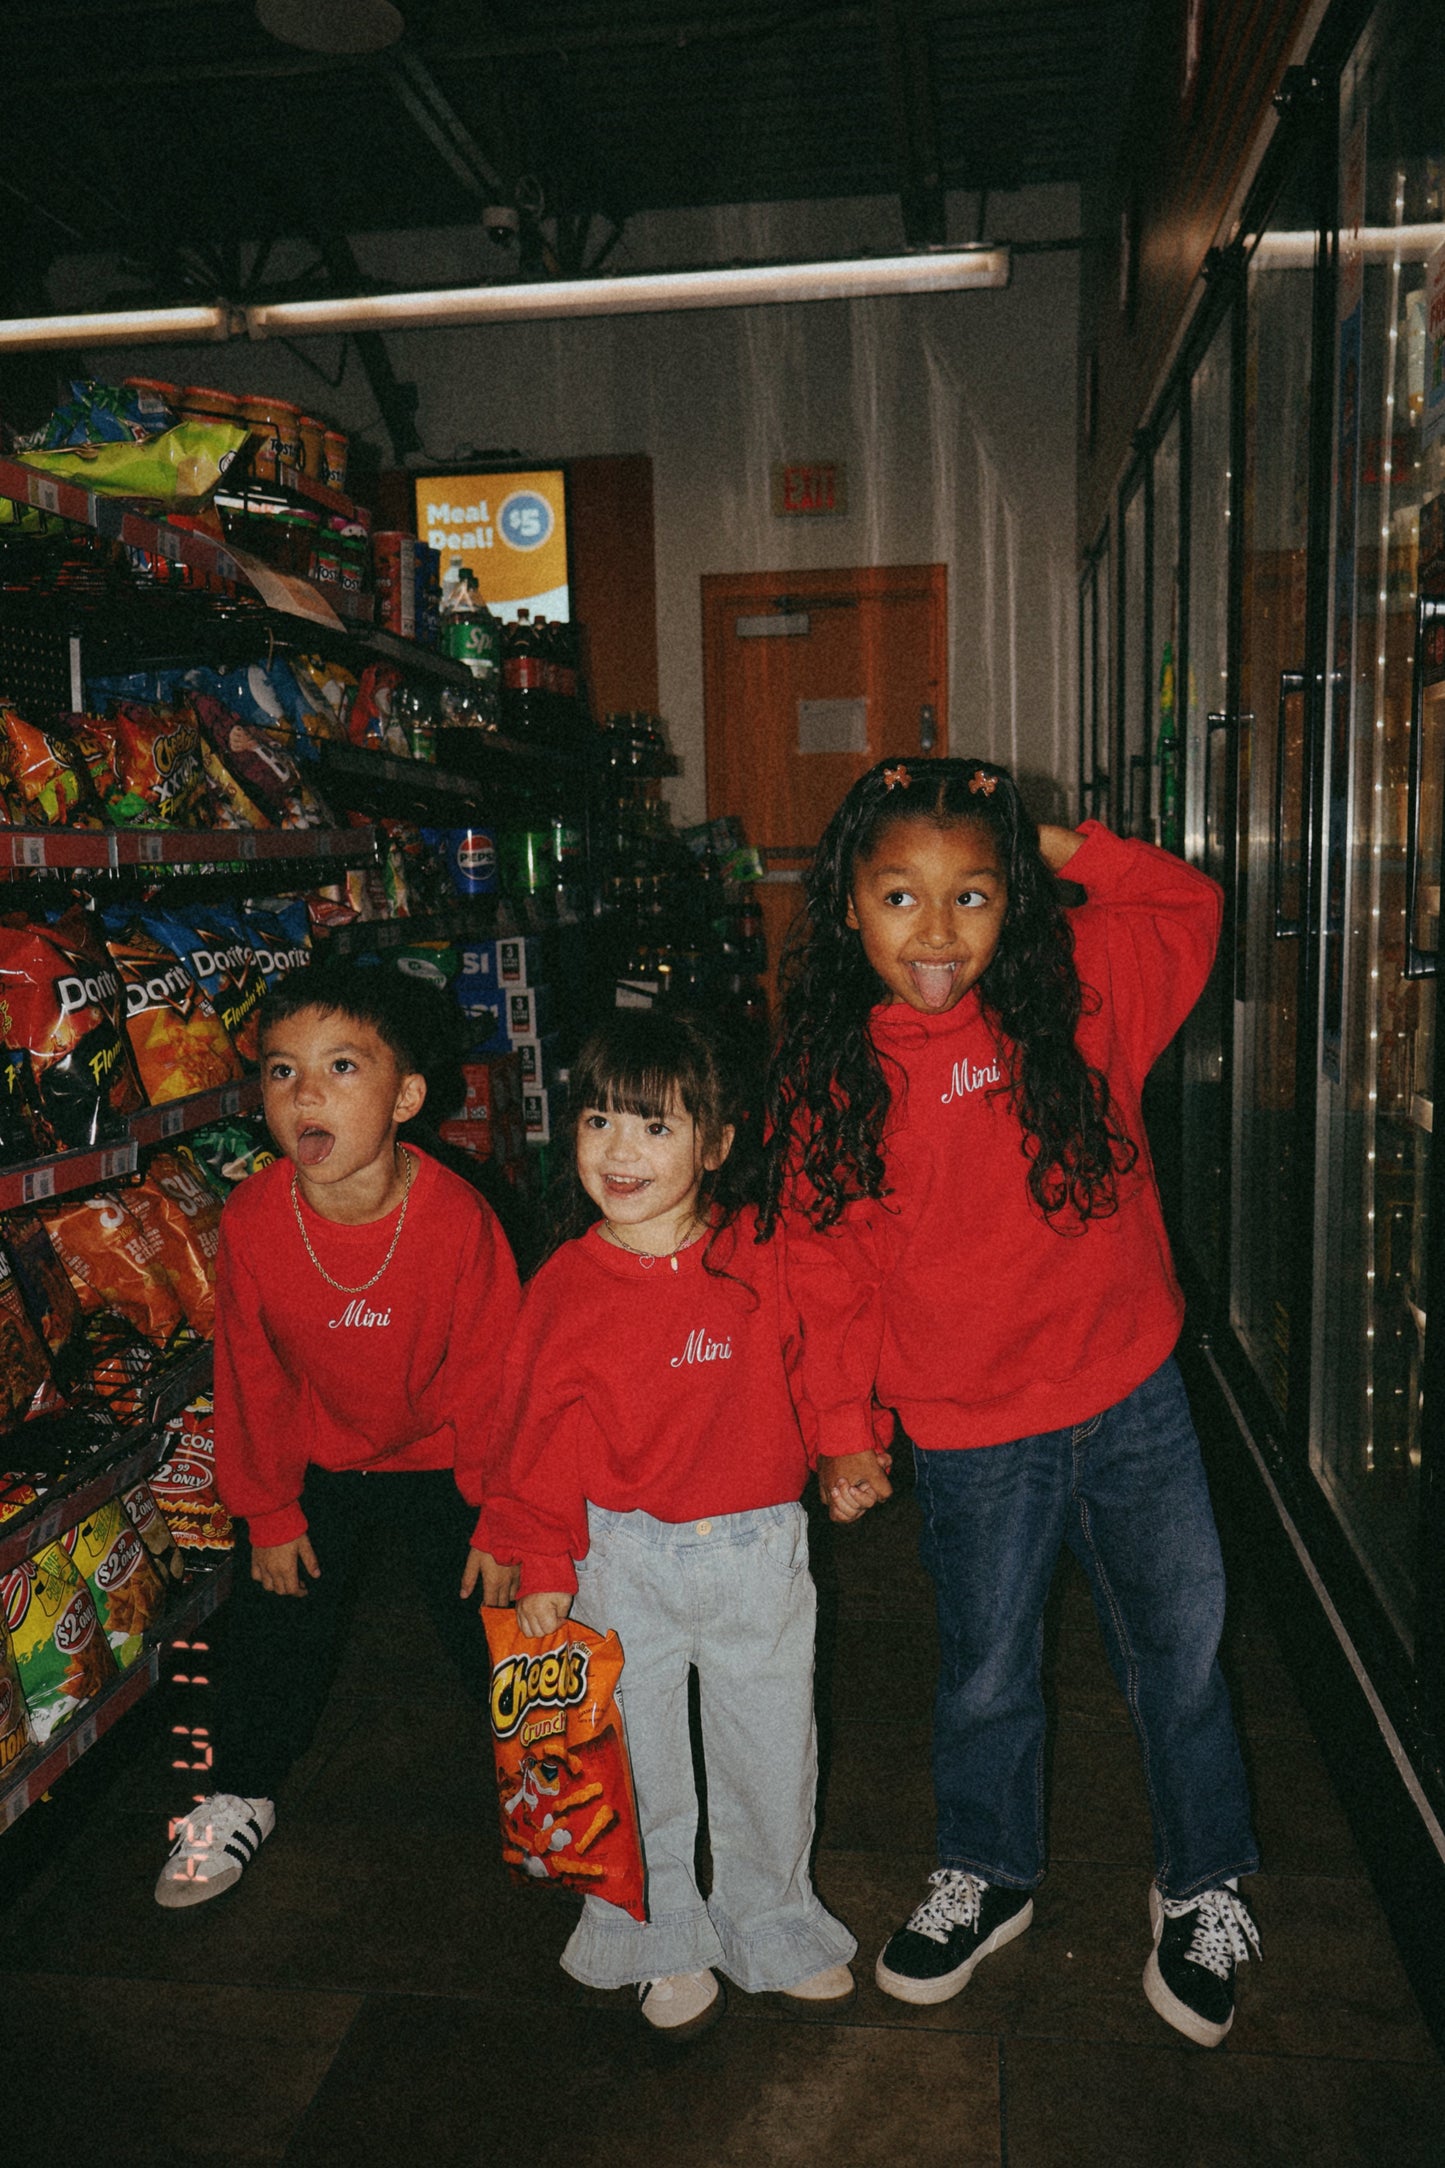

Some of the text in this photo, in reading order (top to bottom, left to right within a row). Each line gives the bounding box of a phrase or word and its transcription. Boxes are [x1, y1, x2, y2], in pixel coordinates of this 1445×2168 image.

[784, 466, 836, 510] EXIT
[426, 501, 491, 525] Meal
[509, 508, 541, 537] $5
[428, 526, 494, 550] Deal!
[459, 852, 495, 863] PEPS
[940, 1057, 1001, 1104] Mini
[328, 1298, 392, 1329] Mini
[669, 1327, 733, 1368] Mini
[171, 1472, 205, 1488] ONLY
[121, 1539, 141, 1567] ONLY
[490, 1643, 587, 1738] Cheetos
